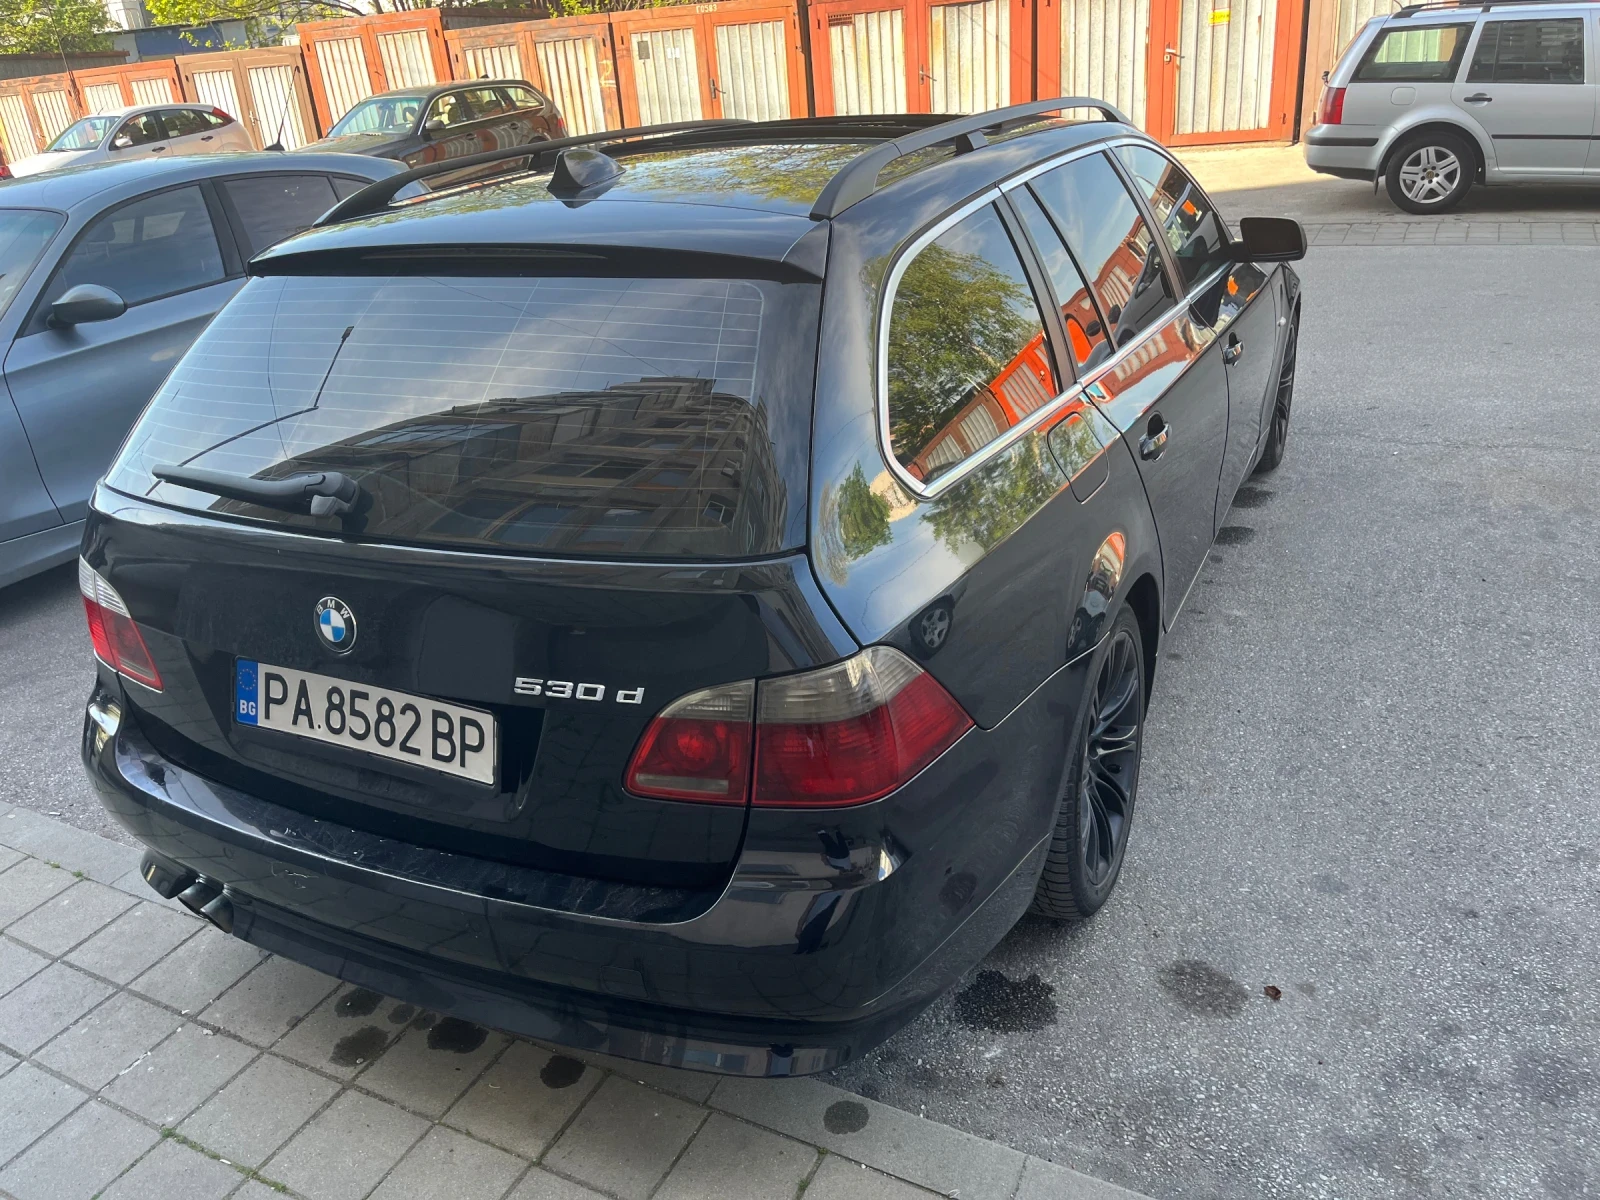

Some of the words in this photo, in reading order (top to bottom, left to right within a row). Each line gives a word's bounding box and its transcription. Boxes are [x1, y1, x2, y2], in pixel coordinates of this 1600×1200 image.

[316, 599, 351, 619] BMW
[513, 676, 606, 702] 530
[615, 687, 645, 704] d
[239, 699, 256, 715] BG
